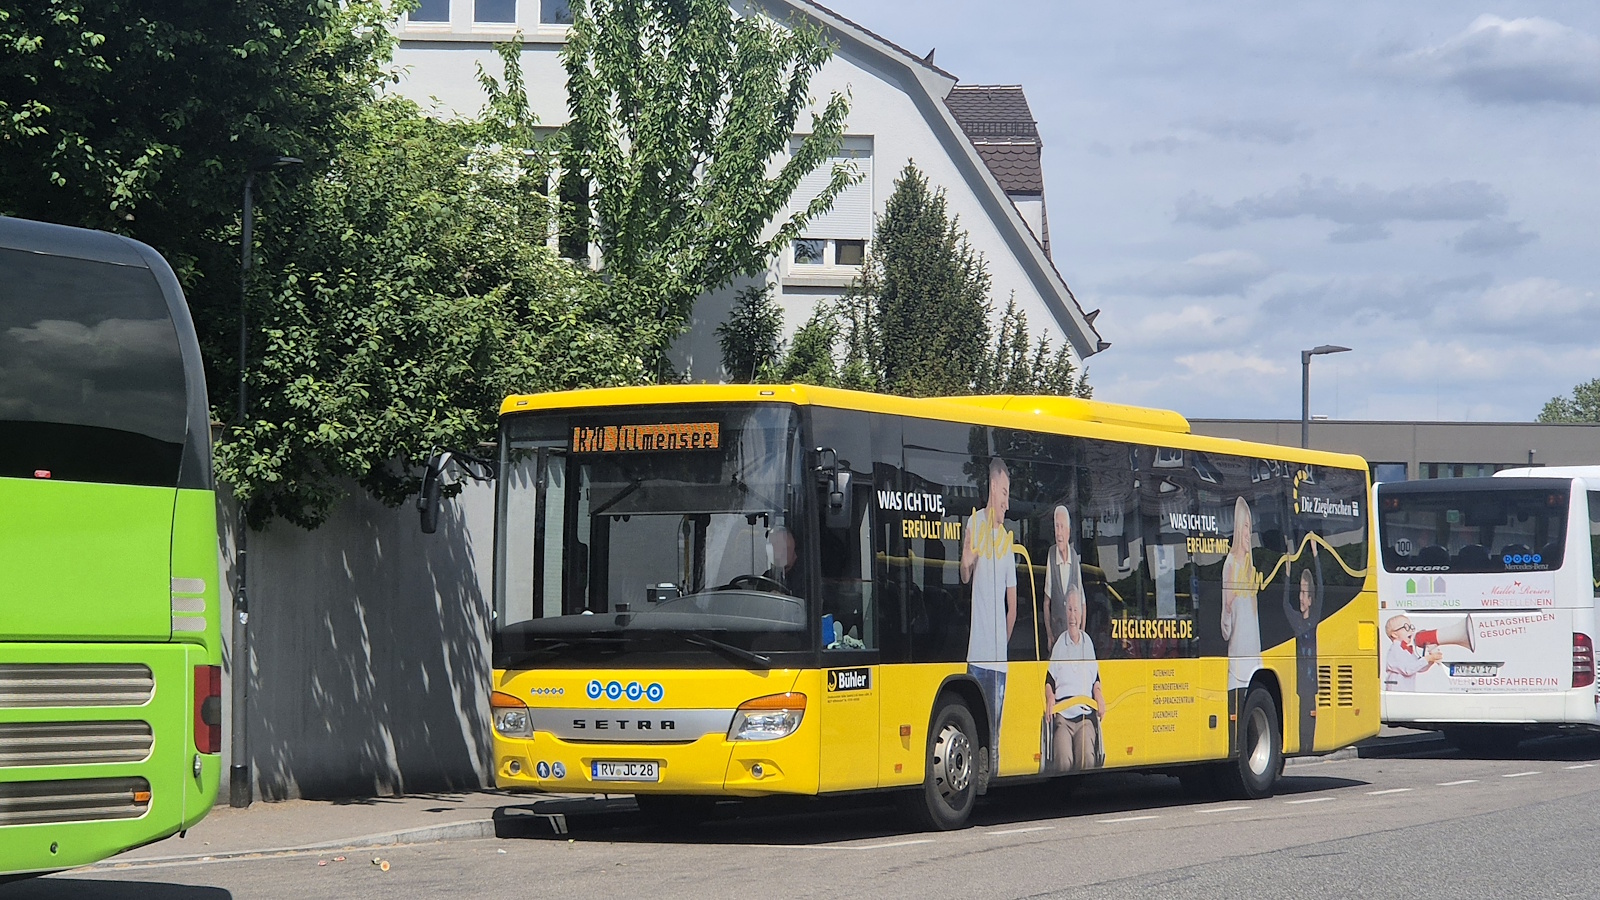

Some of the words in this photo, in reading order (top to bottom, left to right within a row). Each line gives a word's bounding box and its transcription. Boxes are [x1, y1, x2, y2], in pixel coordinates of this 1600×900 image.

[617, 424, 713, 451] Illmensee
[877, 490, 902, 511] WAS
[904, 493, 922, 512] ICH
[923, 494, 946, 517] TUE,
[1301, 496, 1313, 513] Die
[1313, 497, 1352, 518] Zieglerschen
[902, 514, 941, 540] ERFÜLLT
[943, 522, 962, 540] MIT
[1169, 513, 1187, 529] WAS
[1187, 514, 1200, 530] ICH
[1201, 515, 1219, 535] TUE,
[1187, 532, 1215, 554] ERFÜLLT
[1215, 538, 1230, 554] MIT
[1396, 541, 1411, 552] 100
[1503, 554, 1542, 565] bodo
[1504, 563, 1549, 571] Mercedes-Benz
[1111, 619, 1193, 639] ZIEGLERSCHE.DE
[1478, 613, 1556, 629] ALLTAGSHELDEN
[1480, 626, 1527, 639] GESUCHT!
[1455, 665, 1466, 673] RV
[838, 670, 867, 689] Bühler
[586, 680, 664, 702] bodo
[573, 719, 676, 730] SETRA
[601, 763, 616, 776] RV
[623, 763, 638, 776] JC
[639, 763, 654, 777] 28
